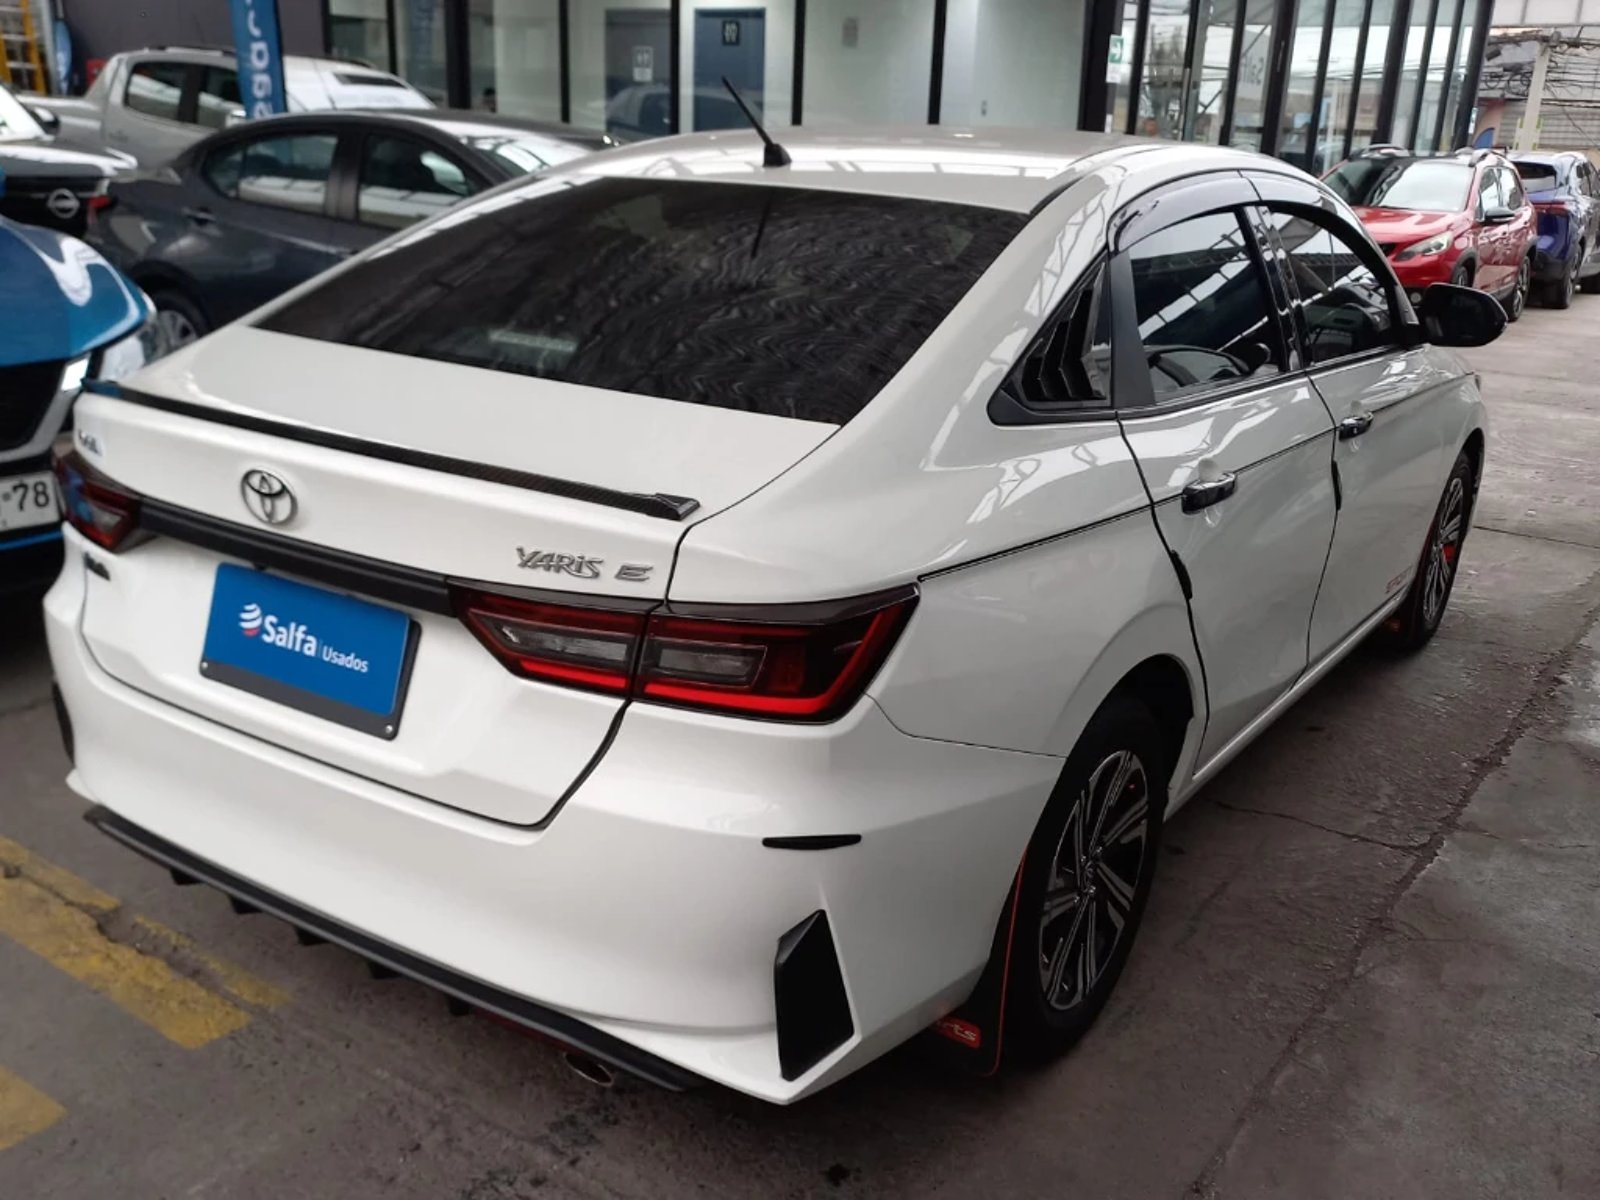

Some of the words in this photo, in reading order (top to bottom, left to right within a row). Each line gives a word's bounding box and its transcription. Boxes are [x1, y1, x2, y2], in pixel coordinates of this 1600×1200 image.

[614, 562, 653, 582] E
[261, 614, 318, 657] Salfa
[322, 645, 369, 673] Usados
